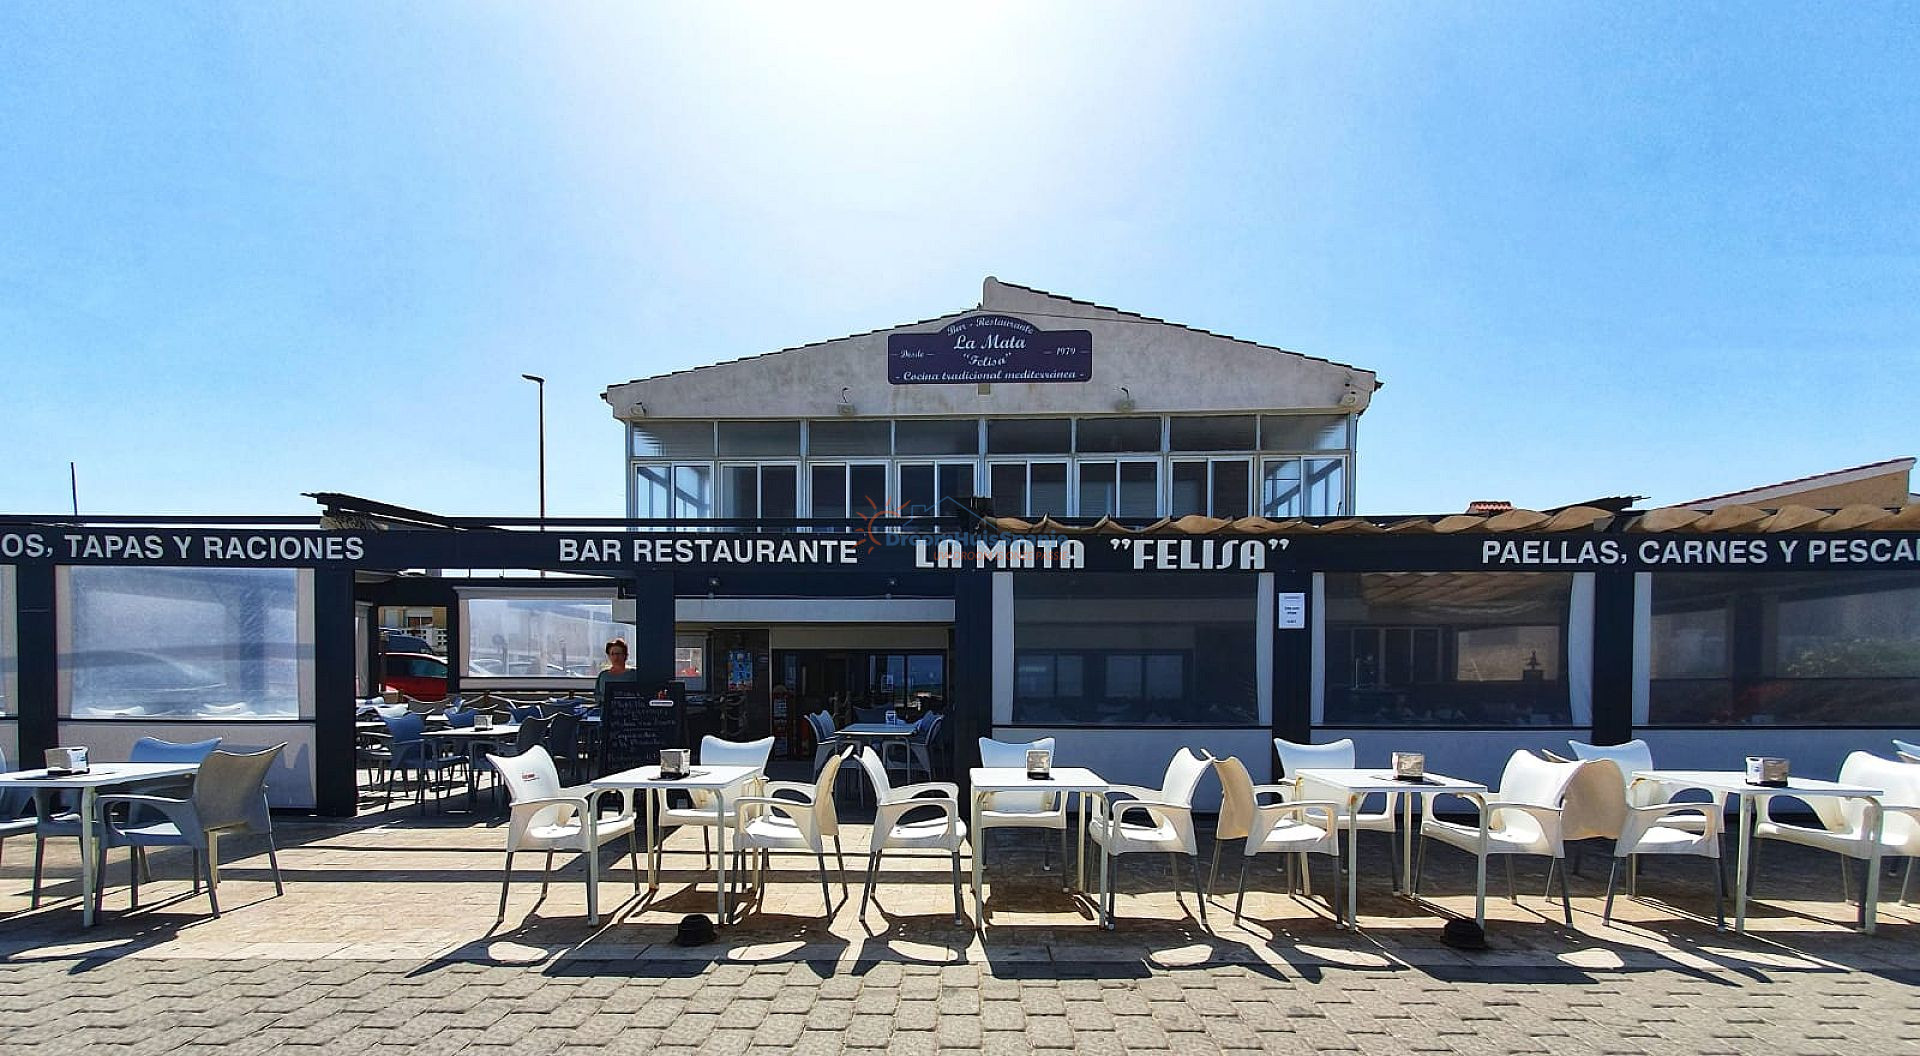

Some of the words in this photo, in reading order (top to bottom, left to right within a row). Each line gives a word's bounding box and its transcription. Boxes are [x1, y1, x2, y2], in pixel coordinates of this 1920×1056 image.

[947, 324, 966, 336] Bar
[976, 316, 1034, 335] Restaurante
[953, 334, 976, 349] La
[980, 334, 1027, 349] Mata
[1056, 347, 1076, 356] 1979
[903, 371, 938, 380] Cocina
[941, 370, 1002, 380] tradicional
[1, 533, 53, 557] OS,
[64, 535, 164, 559] TAPAS
[172, 536, 192, 559] Y
[204, 536, 365, 560] RACIONES
[559, 539, 621, 562] BAR
[633, 539, 858, 563] RESTAURANTE
[915, 539, 962, 568] LA
[976, 539, 1085, 568] MATA
[1482, 540, 1627, 565] PAELLAS,
[1638, 540, 1768, 564] CARNES
[1780, 540, 1798, 563] Y
[1809, 538, 1920, 563] PESCA
